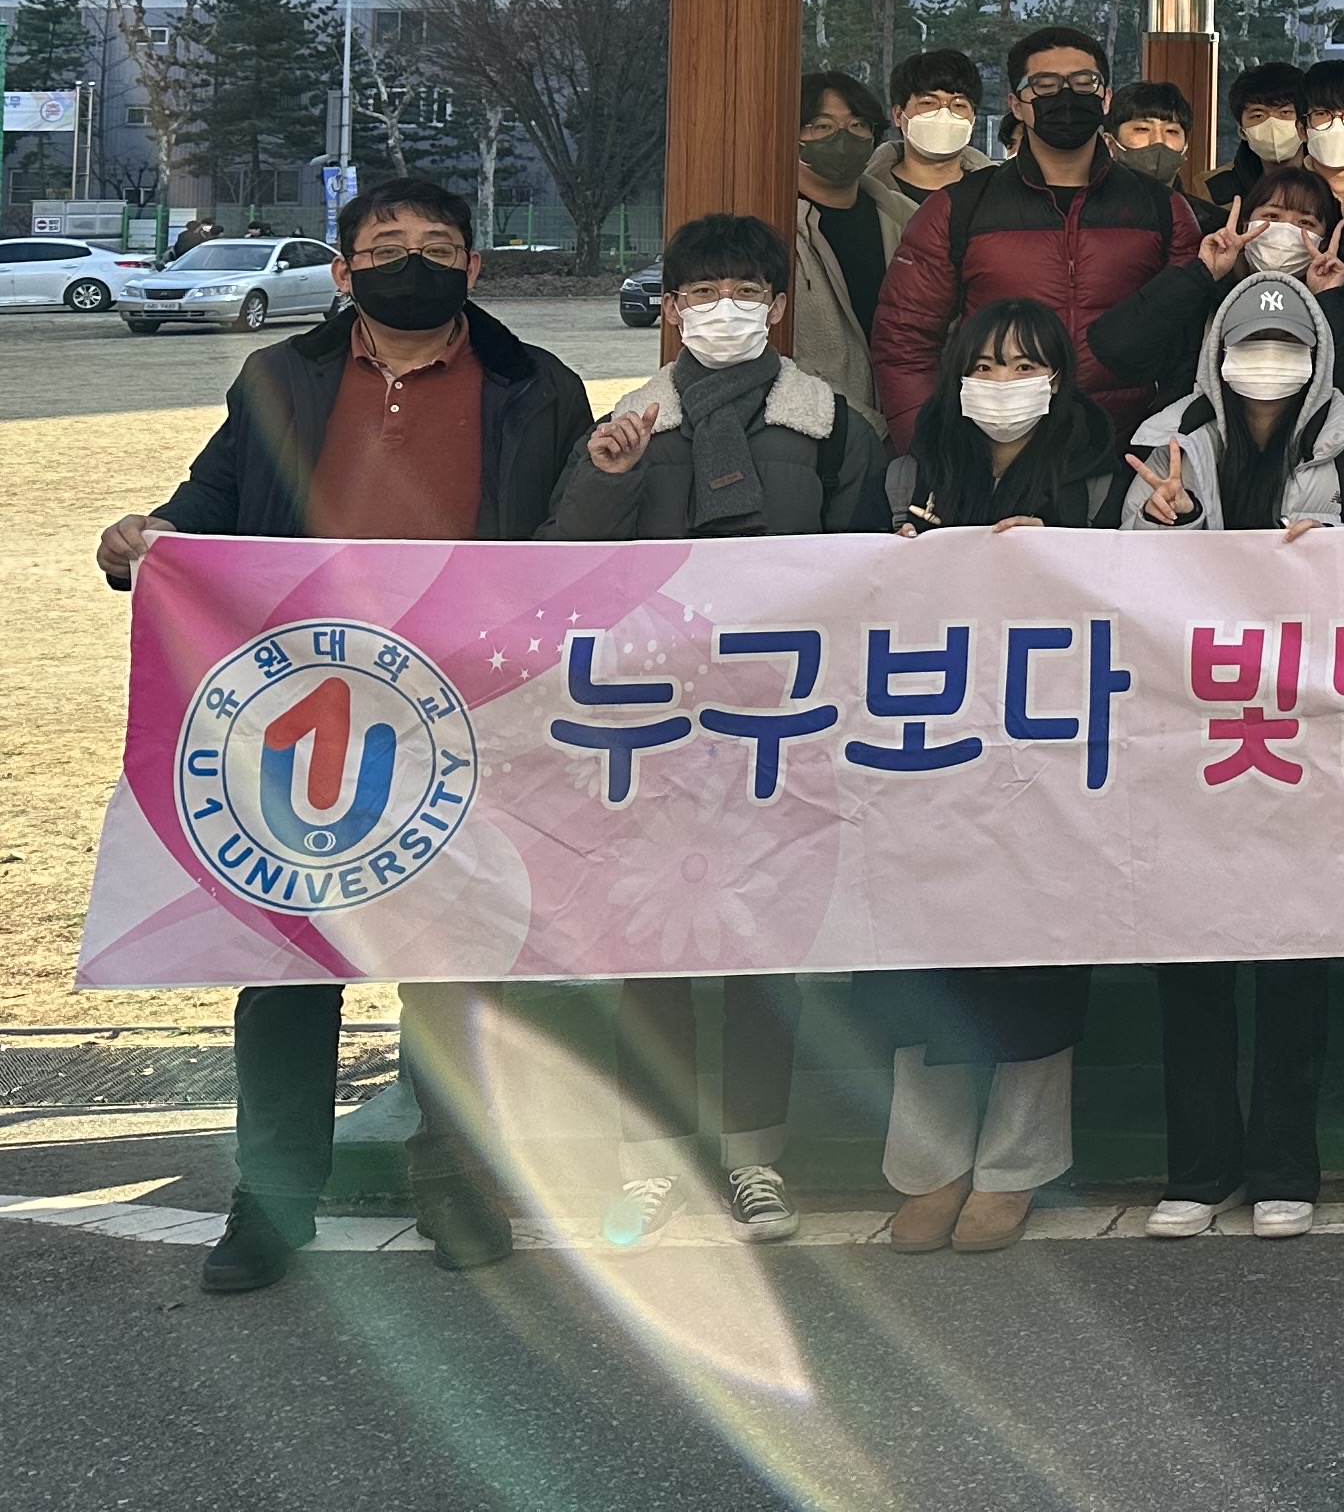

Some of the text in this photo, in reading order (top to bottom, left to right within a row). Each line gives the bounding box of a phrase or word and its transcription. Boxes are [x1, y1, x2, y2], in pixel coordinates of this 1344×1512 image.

[1260, 290, 1284, 311] NY
[206, 629, 457, 725] 유원대학교
[551, 619, 1131, 803] 누구보다
[217, 749, 471, 904] UNIVERSITY
